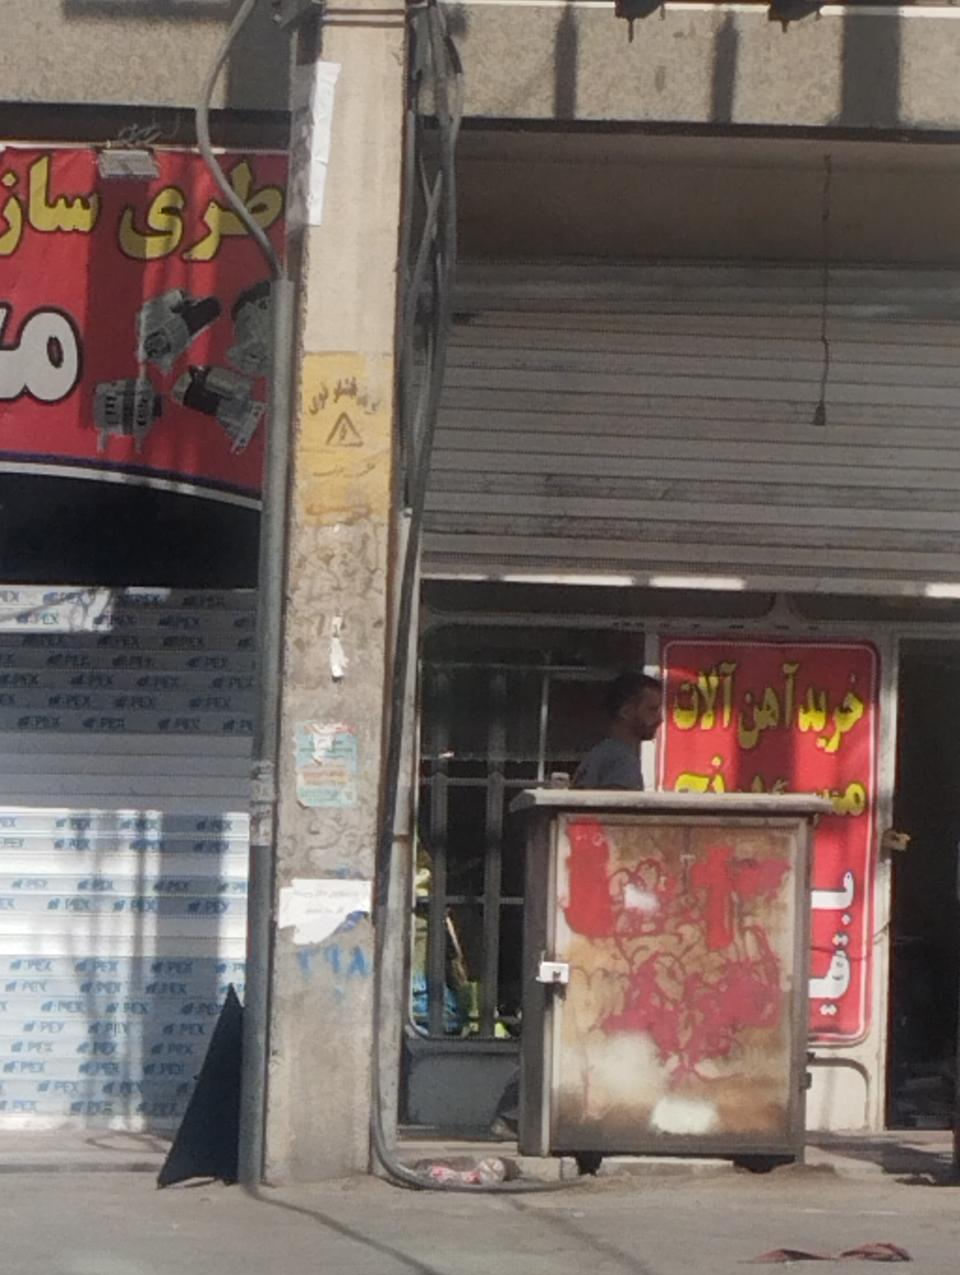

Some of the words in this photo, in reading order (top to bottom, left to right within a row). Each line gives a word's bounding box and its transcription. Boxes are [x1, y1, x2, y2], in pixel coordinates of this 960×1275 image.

[672, 662, 737, 730] آلات
[739, 664, 800, 749] آهن
[798, 675, 865, 753] خرید
